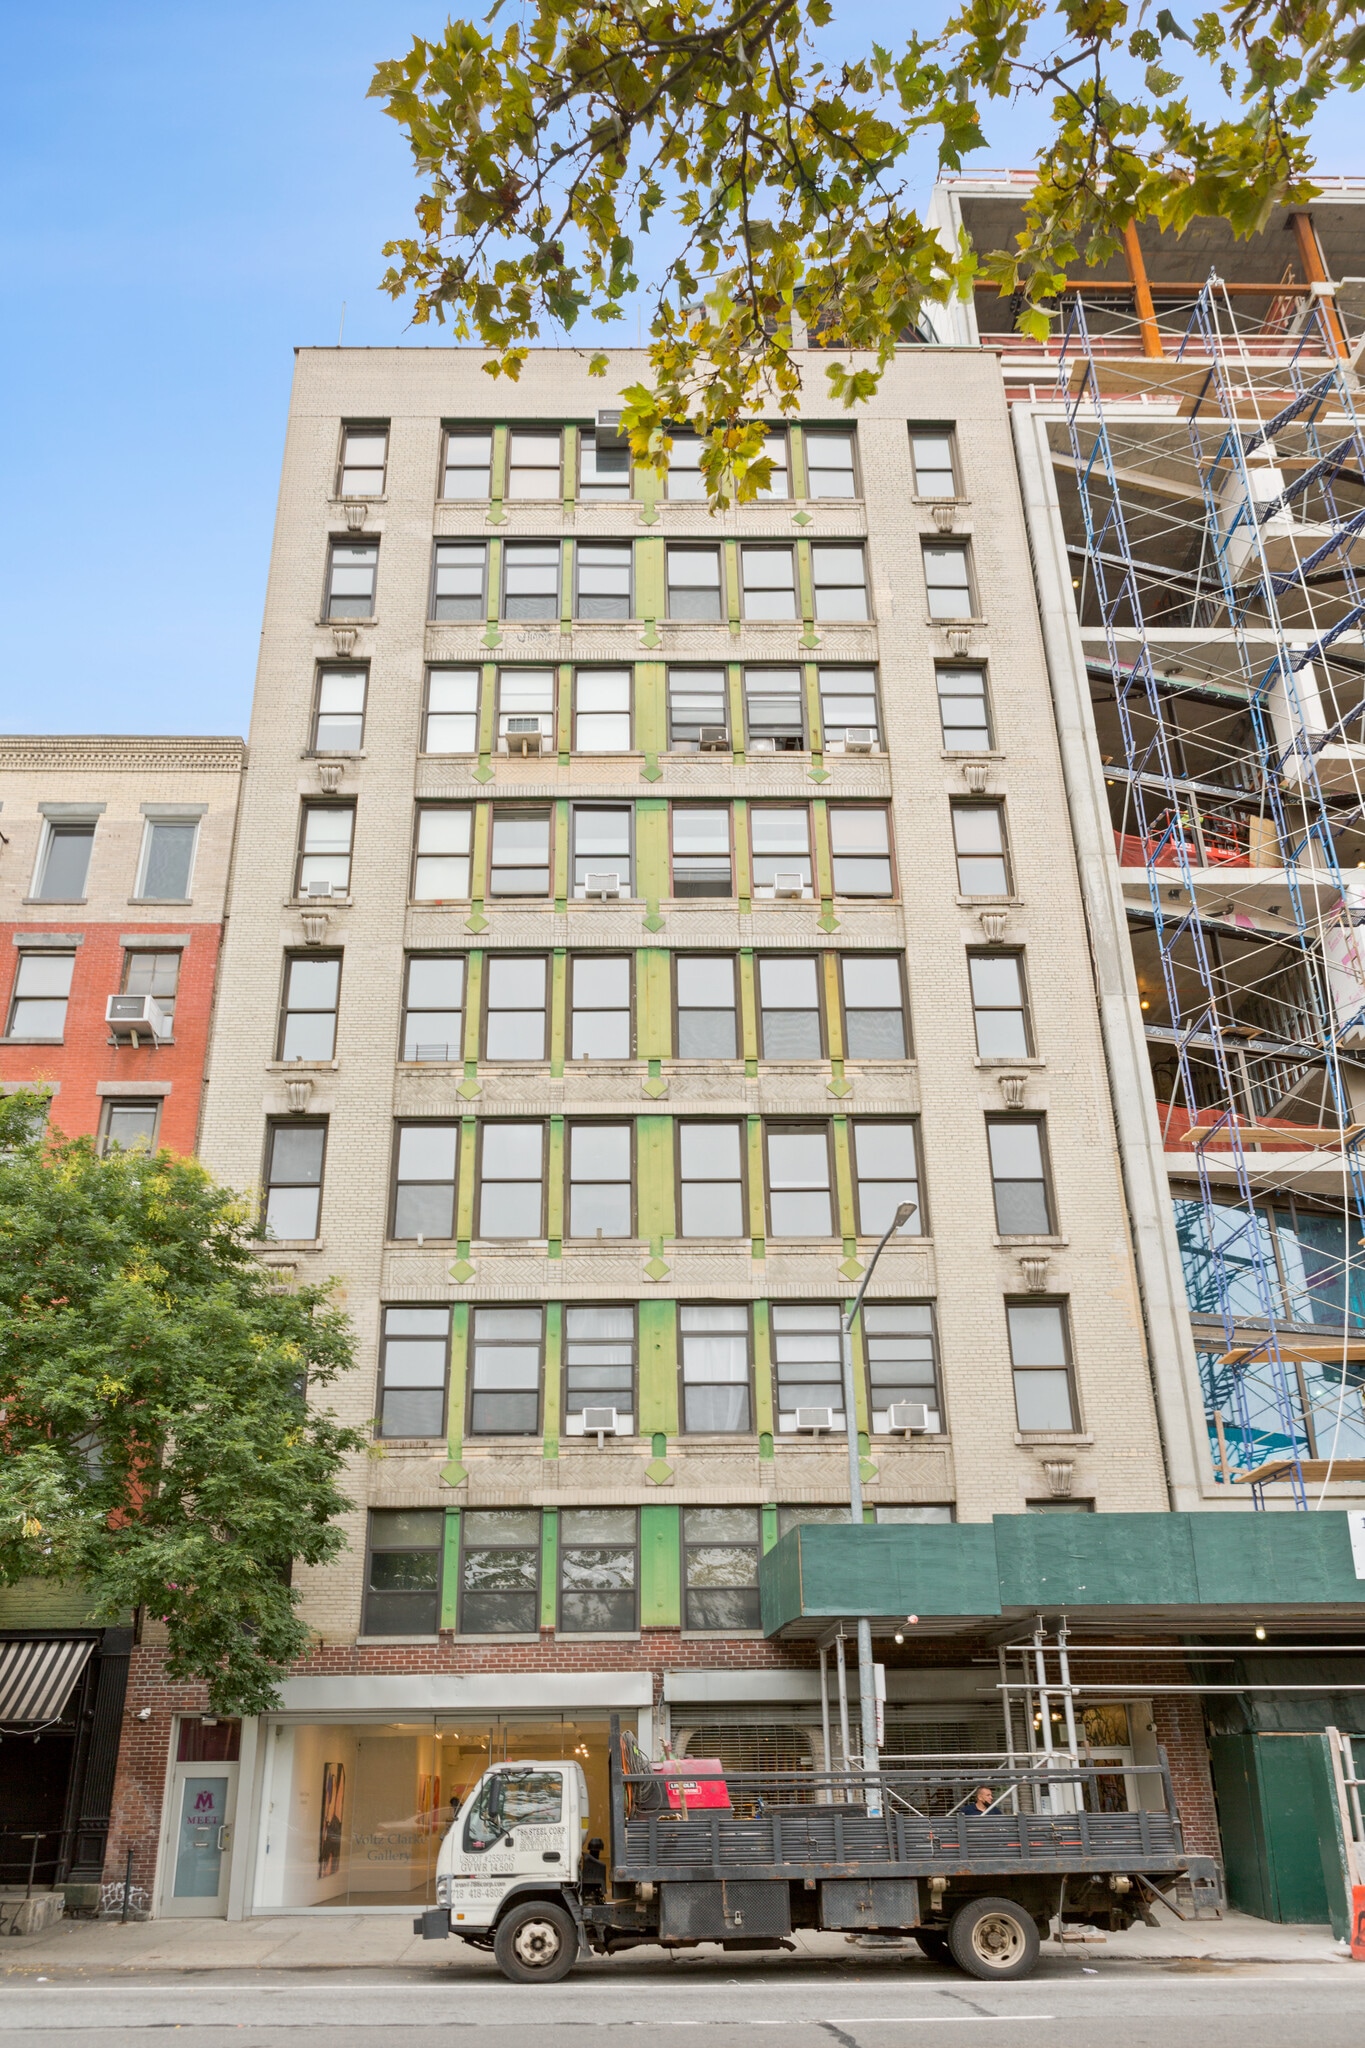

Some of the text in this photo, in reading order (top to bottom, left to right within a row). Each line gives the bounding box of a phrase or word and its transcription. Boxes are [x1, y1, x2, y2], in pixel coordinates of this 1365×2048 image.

[187, 1816, 219, 1825] MEET
[529, 1827, 548, 1836] STEEL
[354, 1833, 385, 1845] Voltz
[367, 1849, 411, 1864] Gallery
[459, 1854, 484, 1863] USDOT
